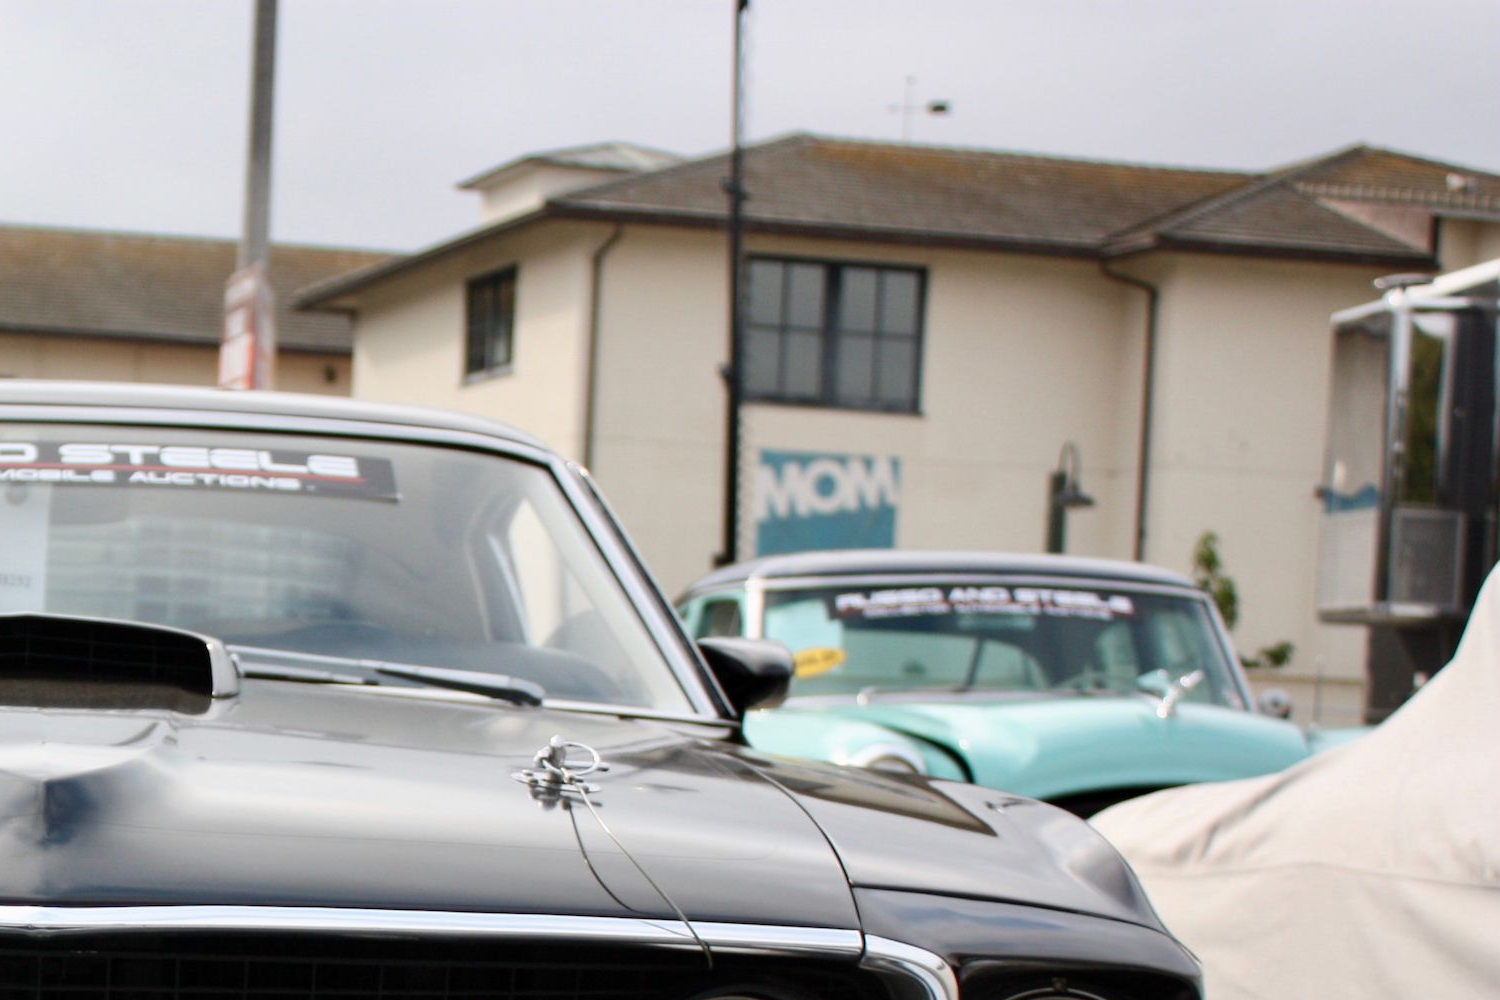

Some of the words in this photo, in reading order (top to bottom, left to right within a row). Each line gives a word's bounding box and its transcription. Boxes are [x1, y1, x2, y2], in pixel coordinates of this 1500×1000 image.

[58, 442, 360, 478] STEELE
[128, 470, 301, 491] AUCTIONS
[755, 456, 900, 519] MOM
